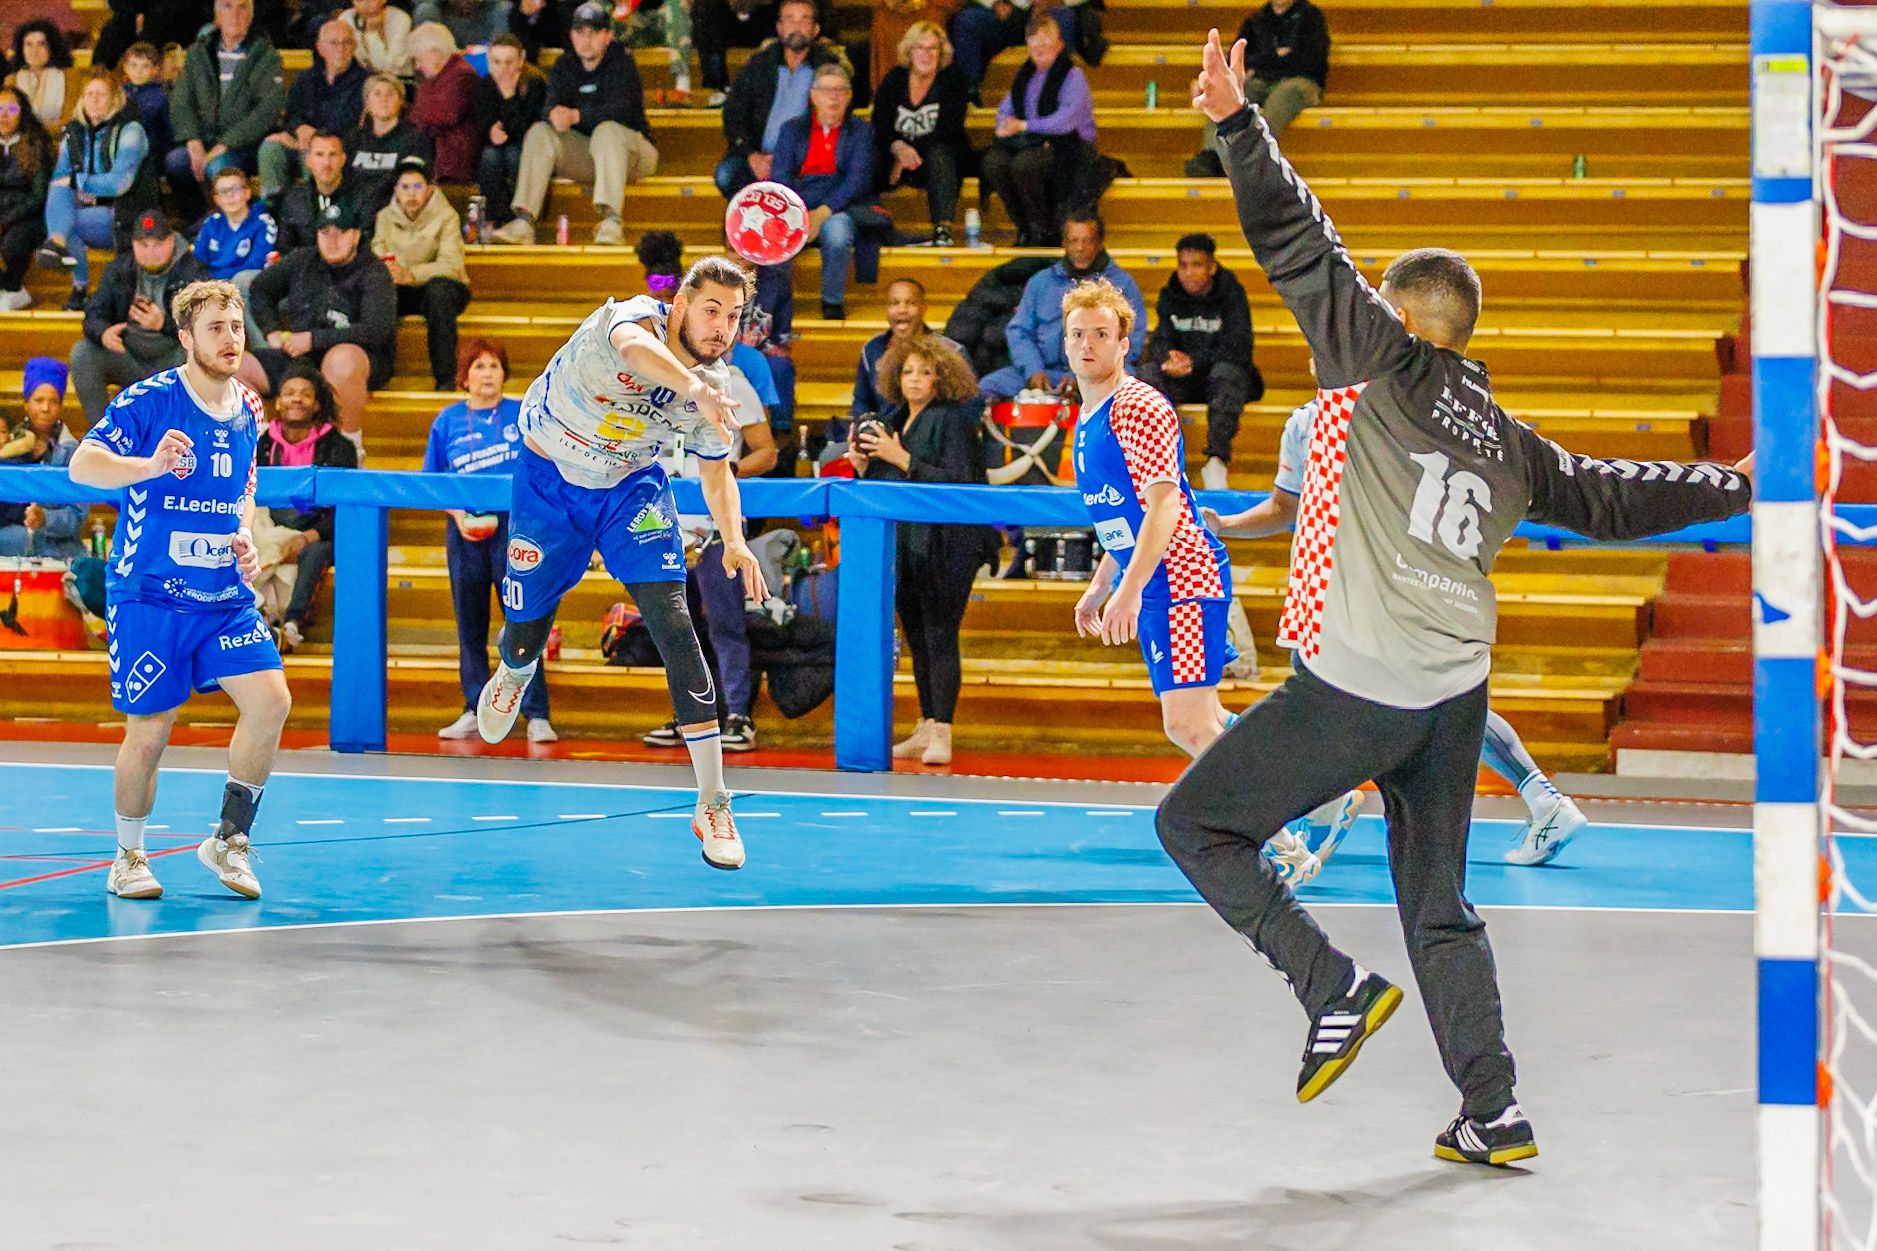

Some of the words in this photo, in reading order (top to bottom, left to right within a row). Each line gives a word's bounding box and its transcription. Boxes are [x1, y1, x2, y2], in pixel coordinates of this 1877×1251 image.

[210, 452, 233, 478] 10
[1407, 450, 1494, 561] 16
[626, 508, 649, 533] LEROY
[502, 576, 524, 611] 30
[218, 628, 263, 651] Rezé
